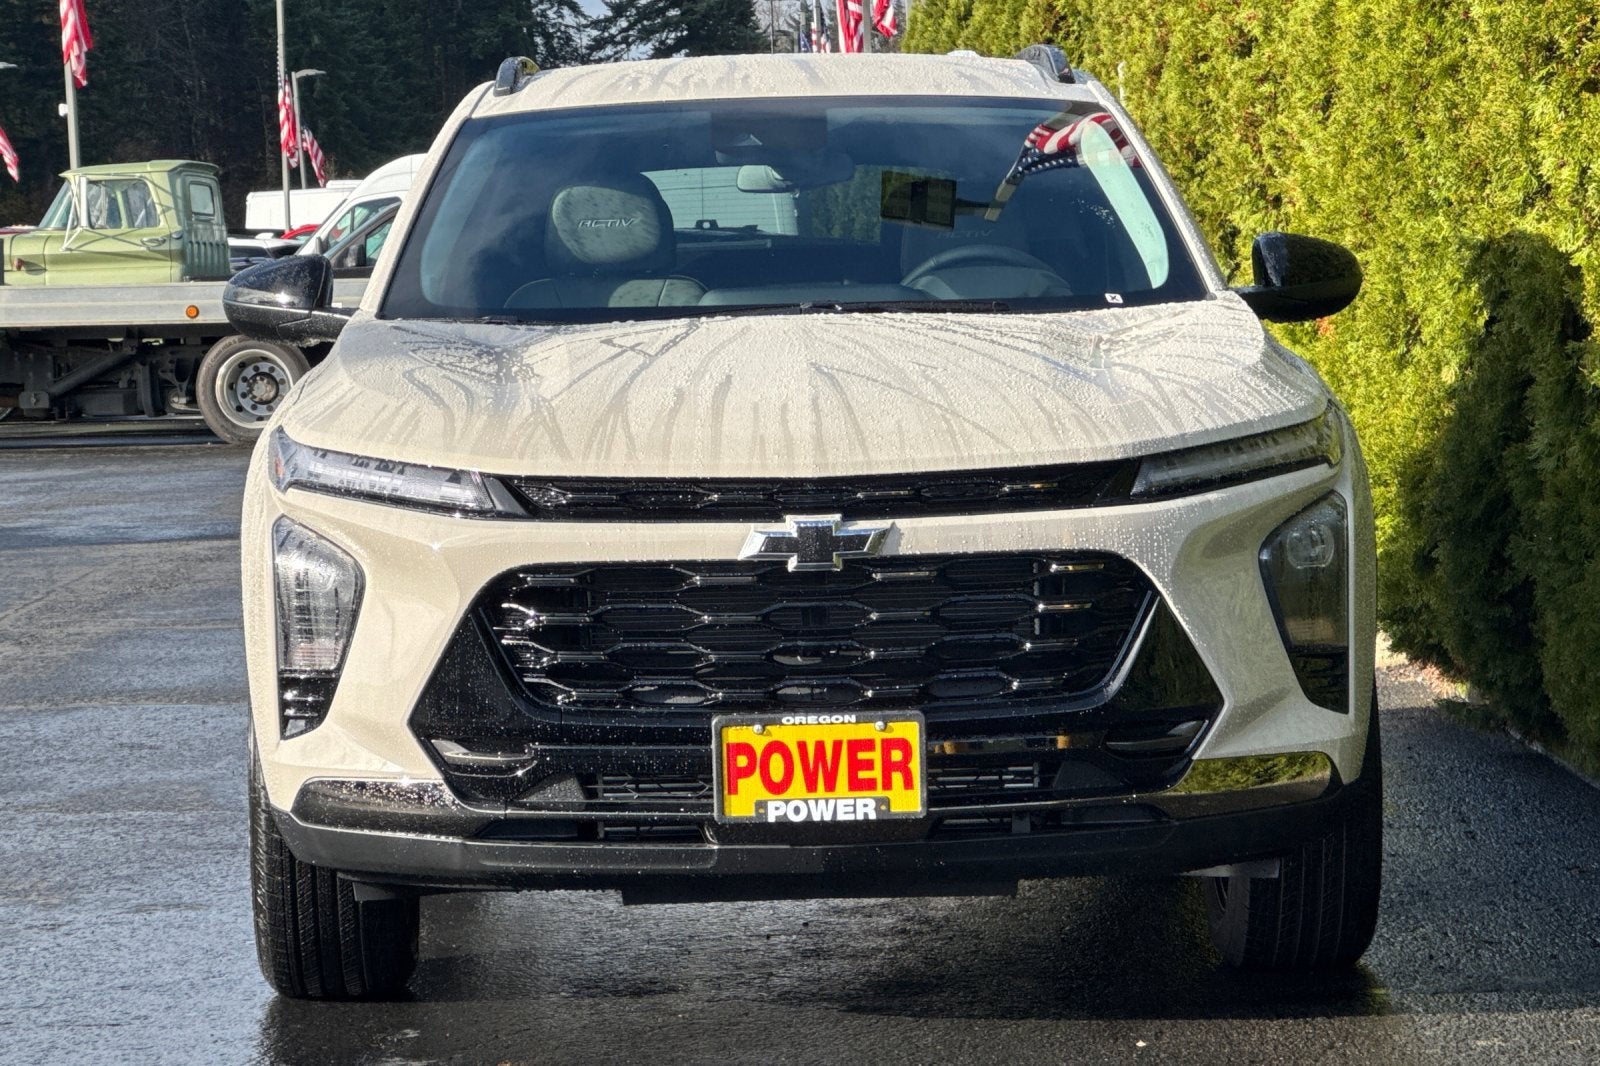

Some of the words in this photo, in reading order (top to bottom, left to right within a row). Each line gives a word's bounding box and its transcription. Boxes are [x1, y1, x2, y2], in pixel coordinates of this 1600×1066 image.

[578, 217, 637, 228] ACTIV
[781, 714, 857, 725] OREGON
[726, 737, 914, 796] POWER
[767, 798, 877, 823] POWER
